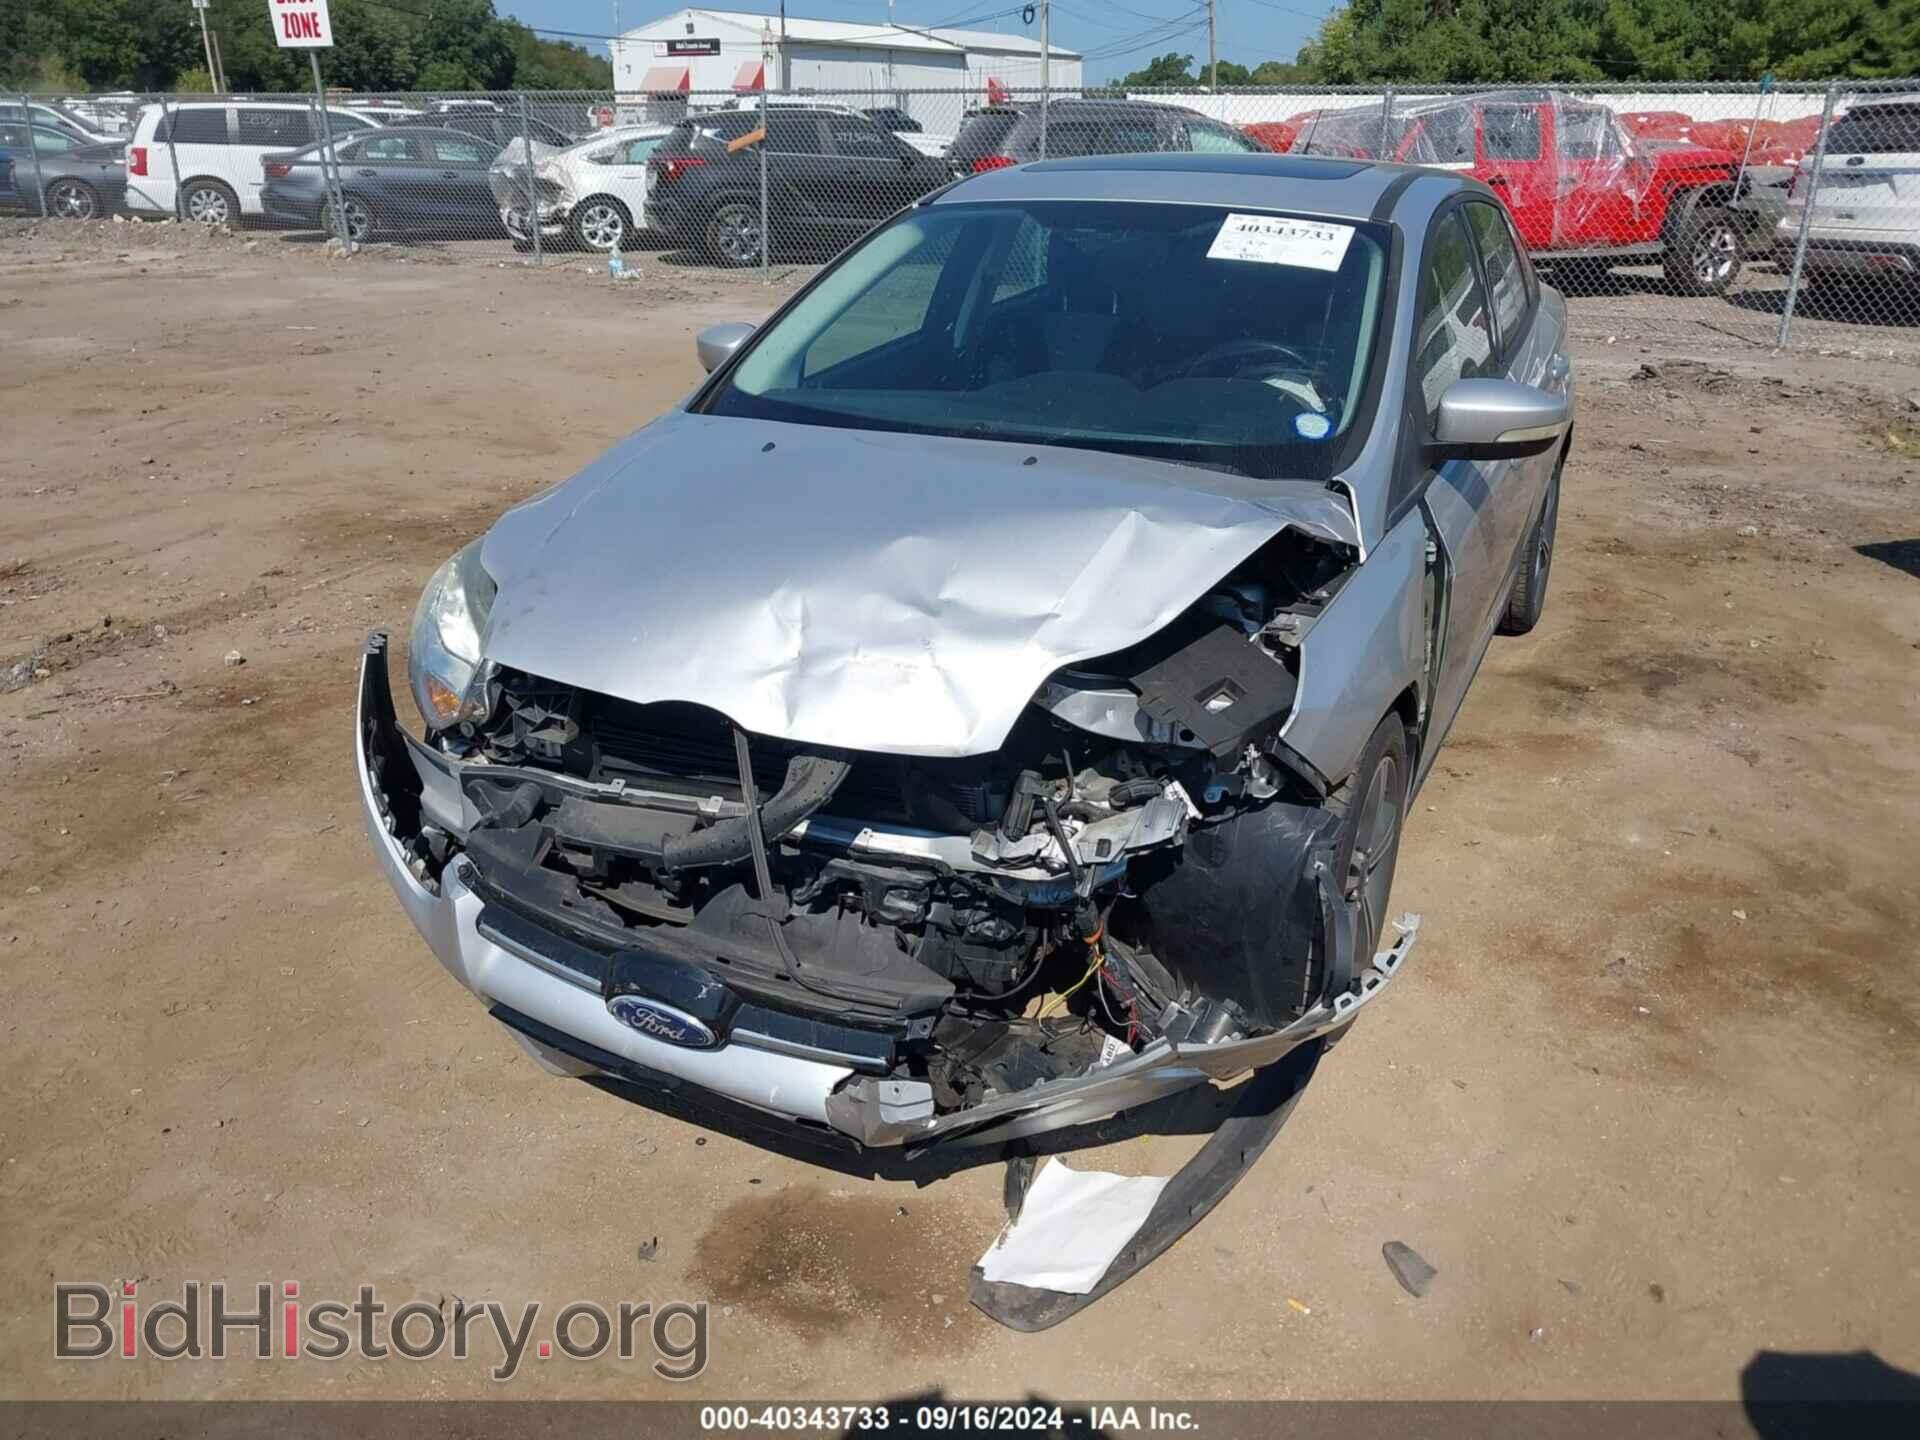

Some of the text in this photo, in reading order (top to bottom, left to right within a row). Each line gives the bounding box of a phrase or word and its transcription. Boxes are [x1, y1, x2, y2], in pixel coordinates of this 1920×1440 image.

[281, 12, 322, 39] ZONE
[1235, 223, 1335, 240] 40343733
[631, 1007, 686, 1041] Ford
